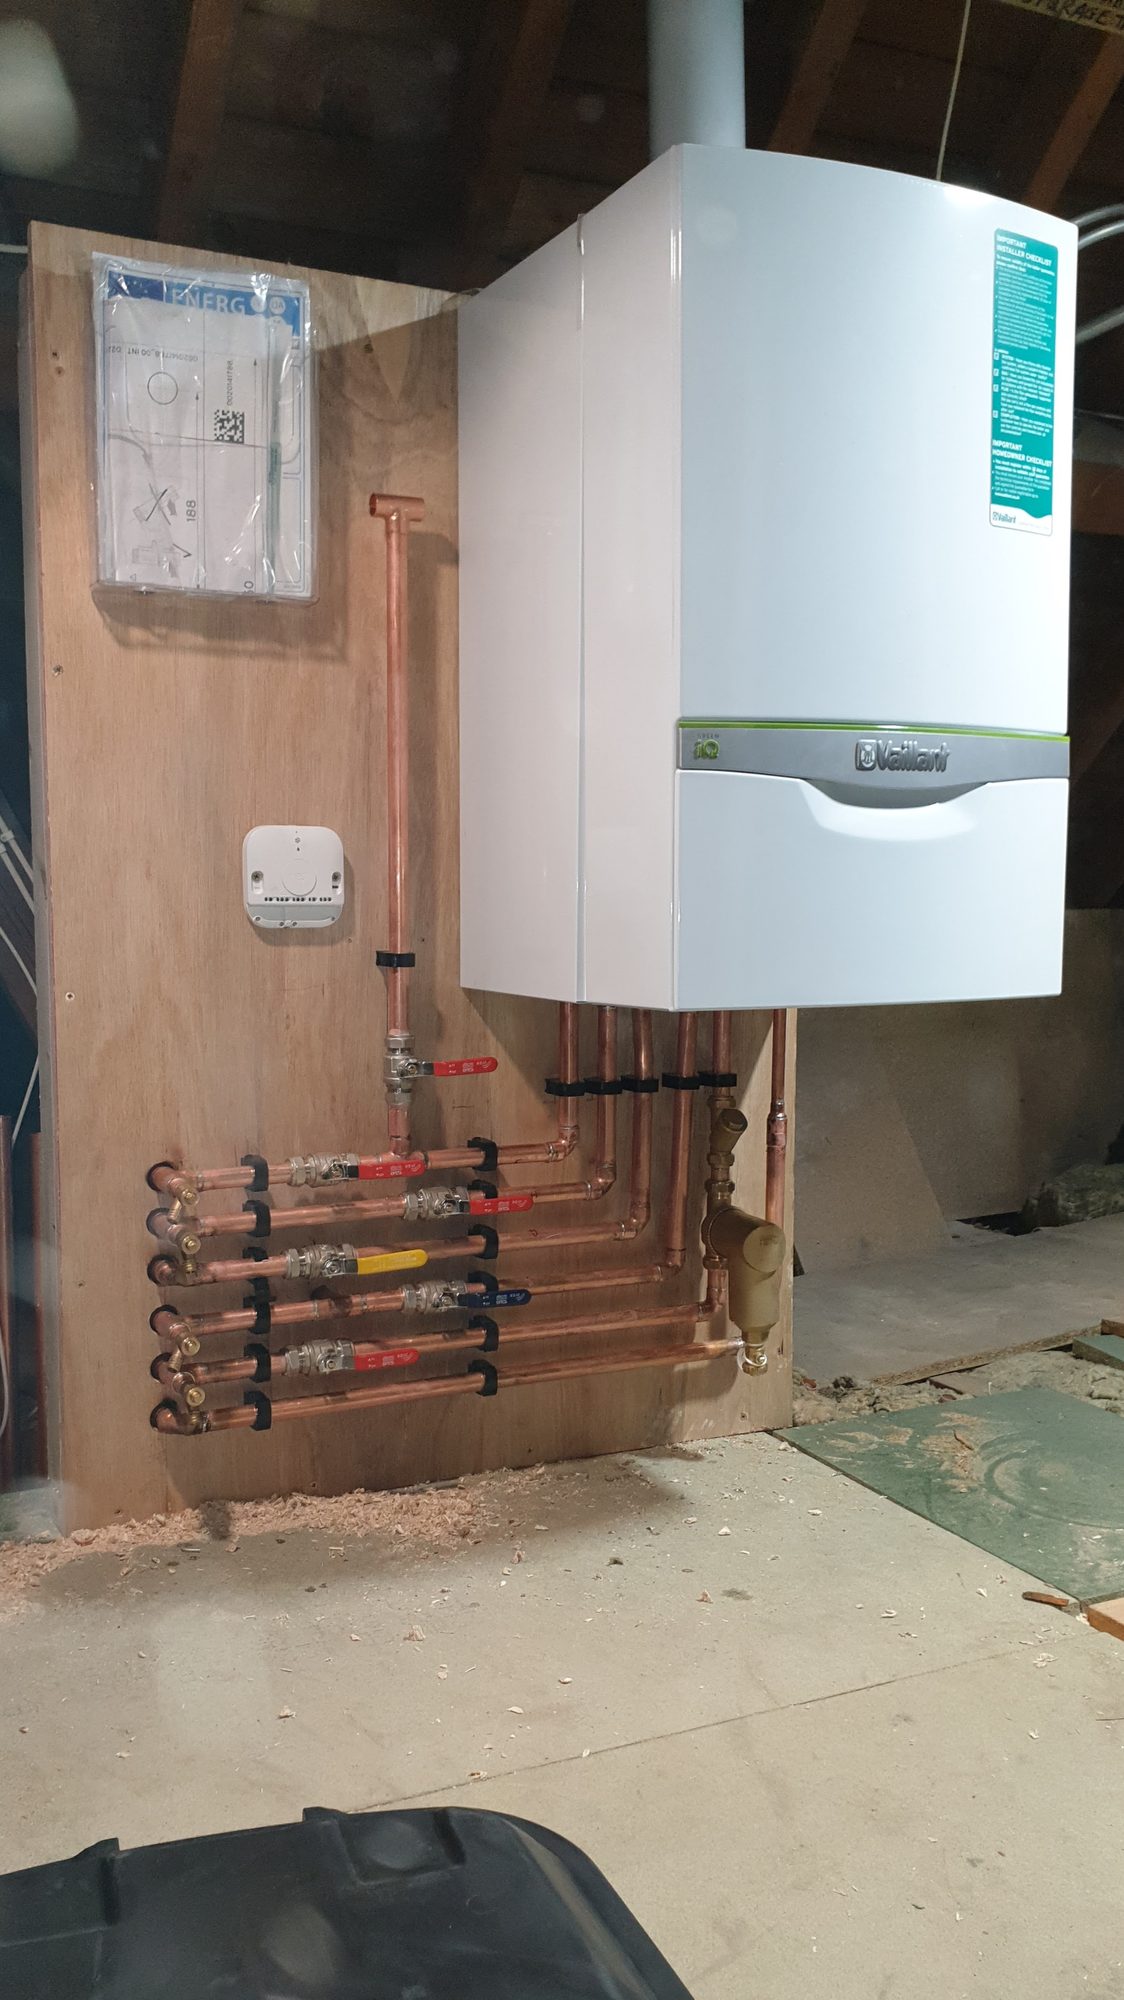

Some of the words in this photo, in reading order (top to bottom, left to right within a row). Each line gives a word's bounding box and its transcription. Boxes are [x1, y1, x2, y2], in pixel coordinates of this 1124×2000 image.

[172, 287, 245, 318] ENERG
[992, 439, 1023, 451] IMPORTANT
[1026, 455, 1053, 467] CHECKLIST
[186, 499, 197, 522] 188
[877, 738, 950, 772] Vaillant
